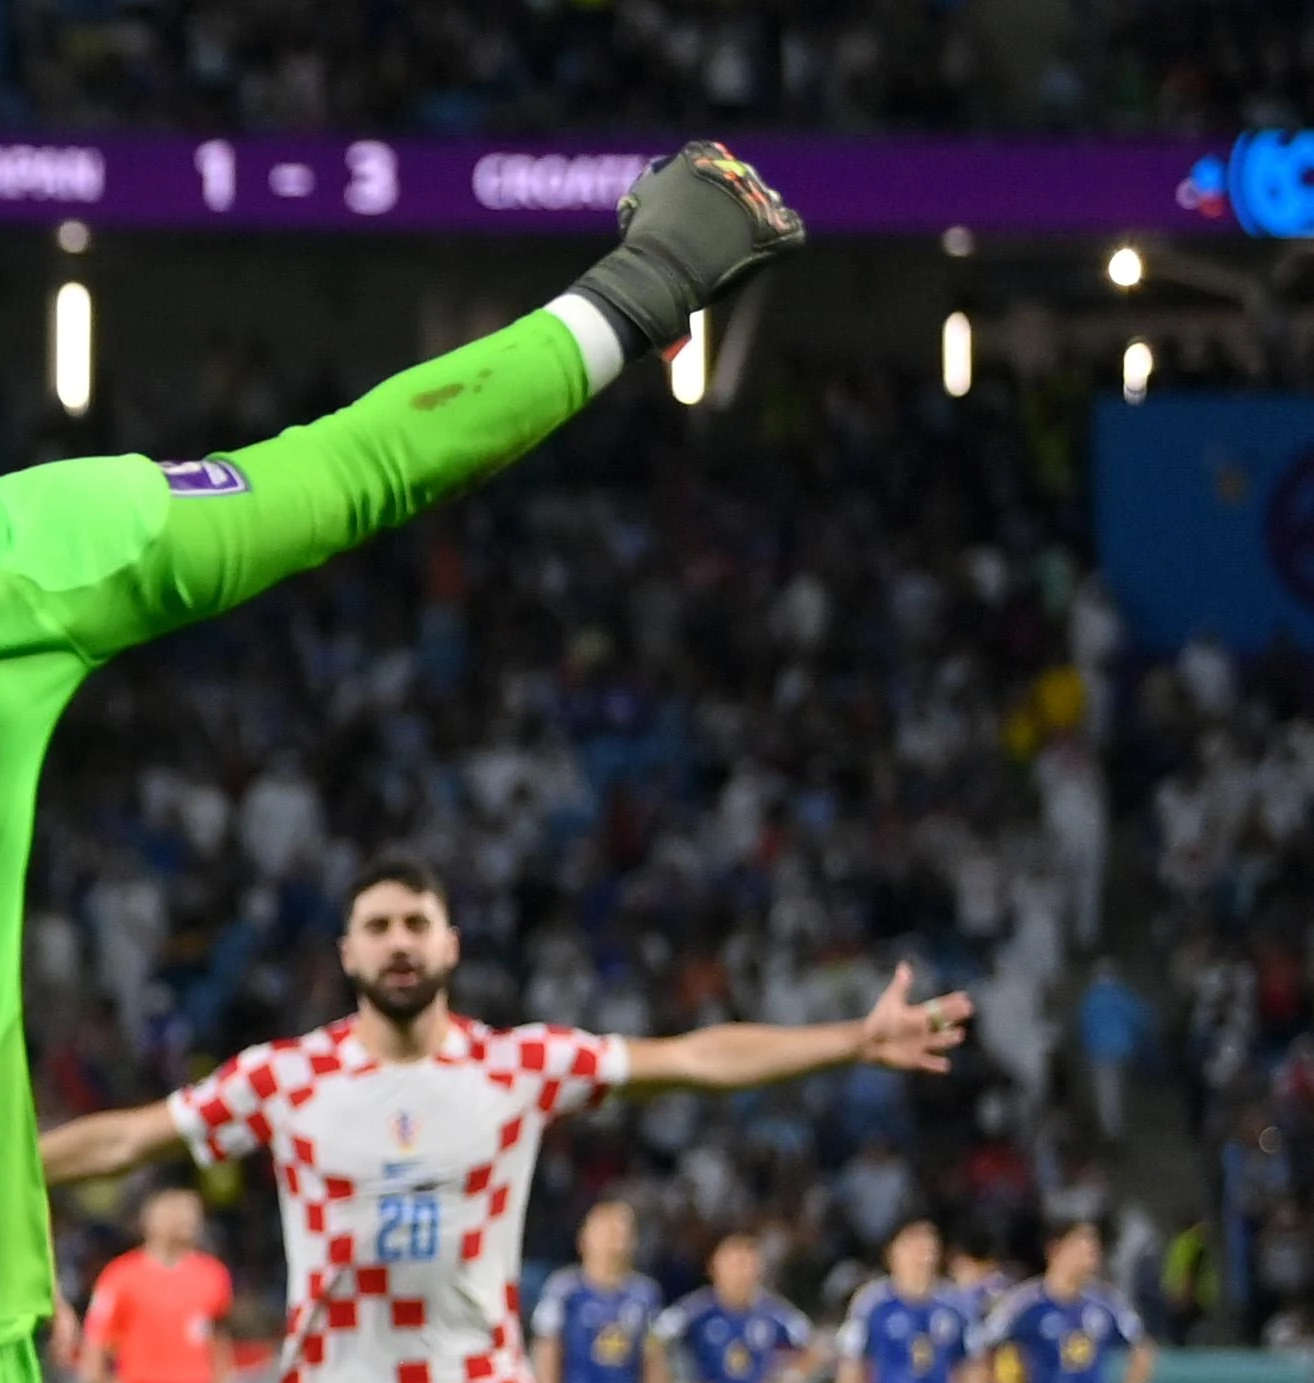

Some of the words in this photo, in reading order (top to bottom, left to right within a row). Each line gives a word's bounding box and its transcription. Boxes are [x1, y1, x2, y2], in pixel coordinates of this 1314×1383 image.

[195, 140, 236, 211] 1
[344, 140, 398, 214] 3
[377, 1194, 440, 1263] 20
